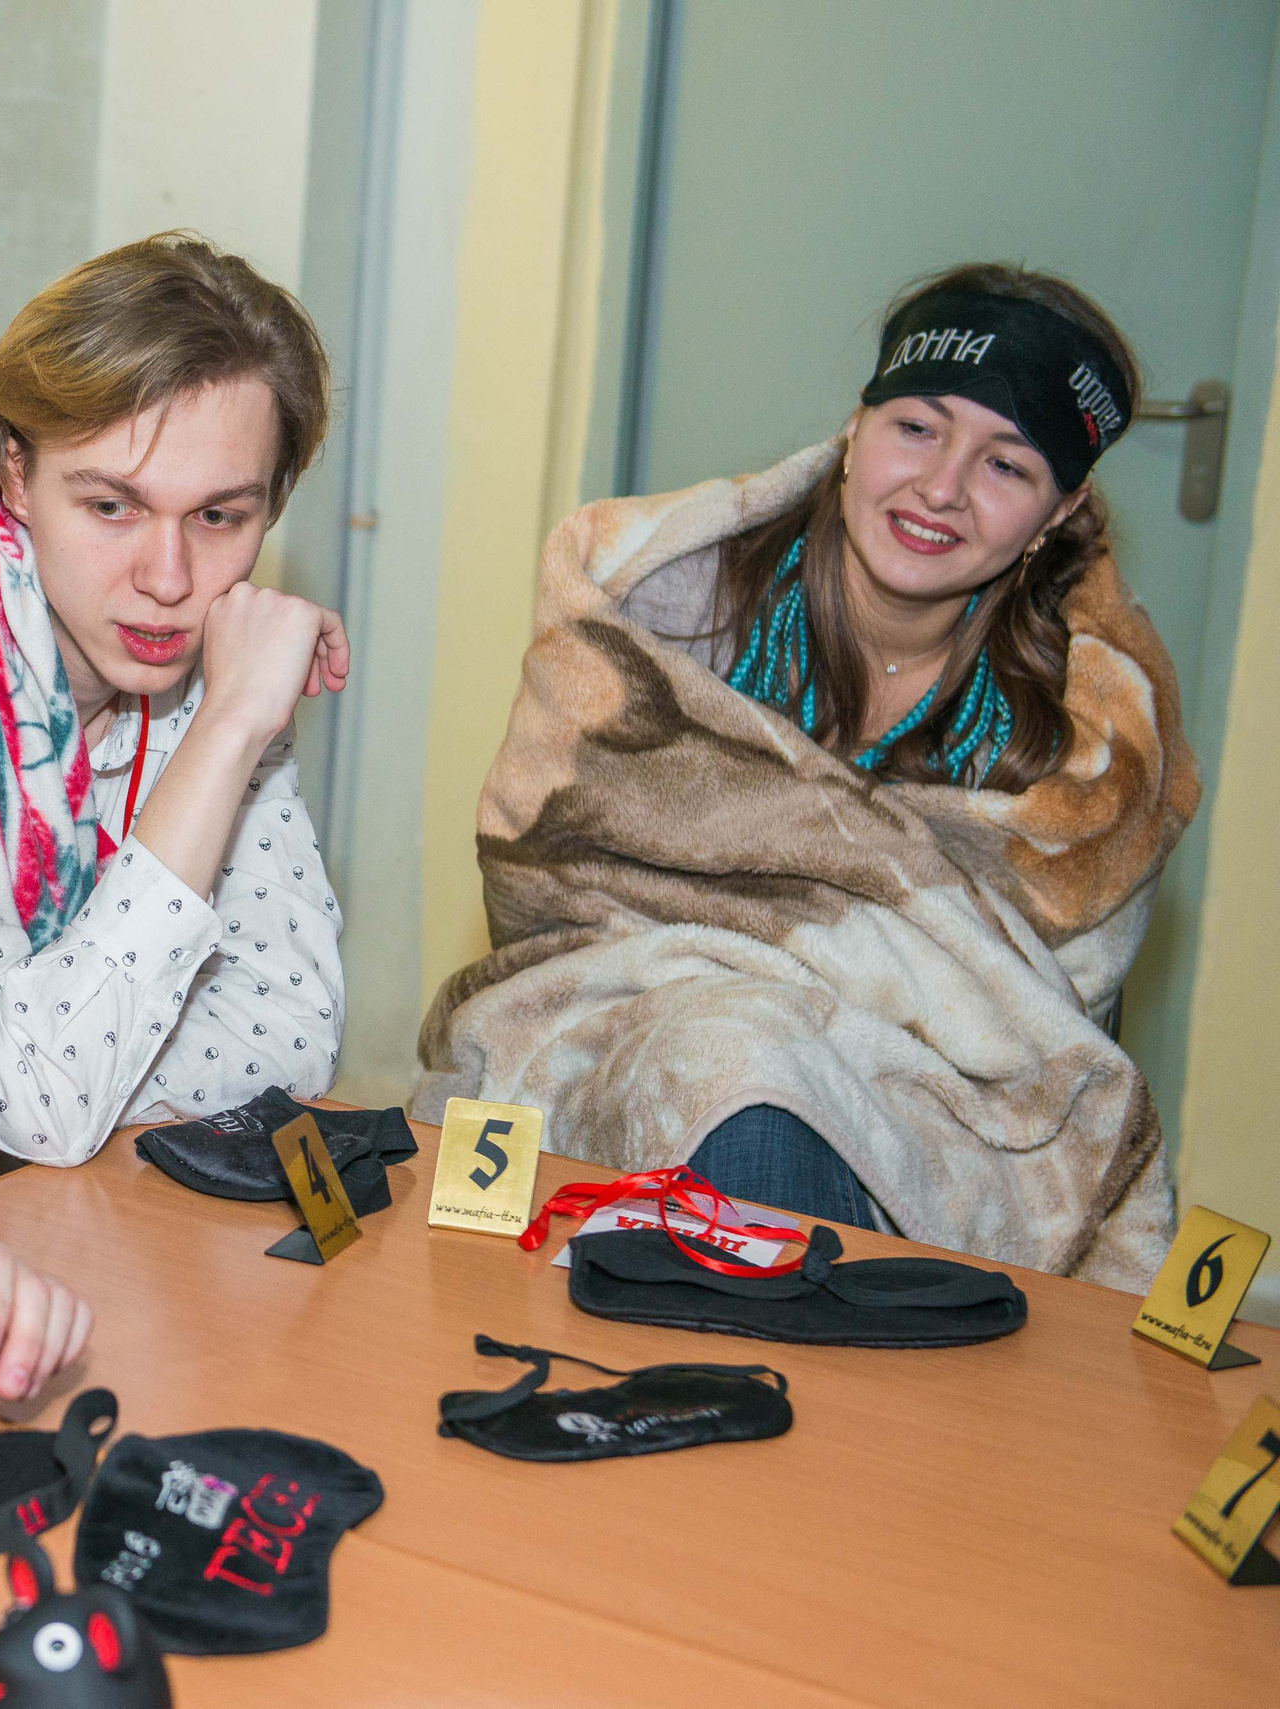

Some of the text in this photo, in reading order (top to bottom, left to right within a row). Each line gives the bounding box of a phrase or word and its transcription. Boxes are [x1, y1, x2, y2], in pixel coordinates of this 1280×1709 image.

[883, 328, 997, 377] ДОННА
[298, 1135, 332, 1204] 4
[469, 1118, 514, 1191] 5
[1185, 1233, 1237, 1308] 6
[1220, 1428, 1280, 1518] 7
